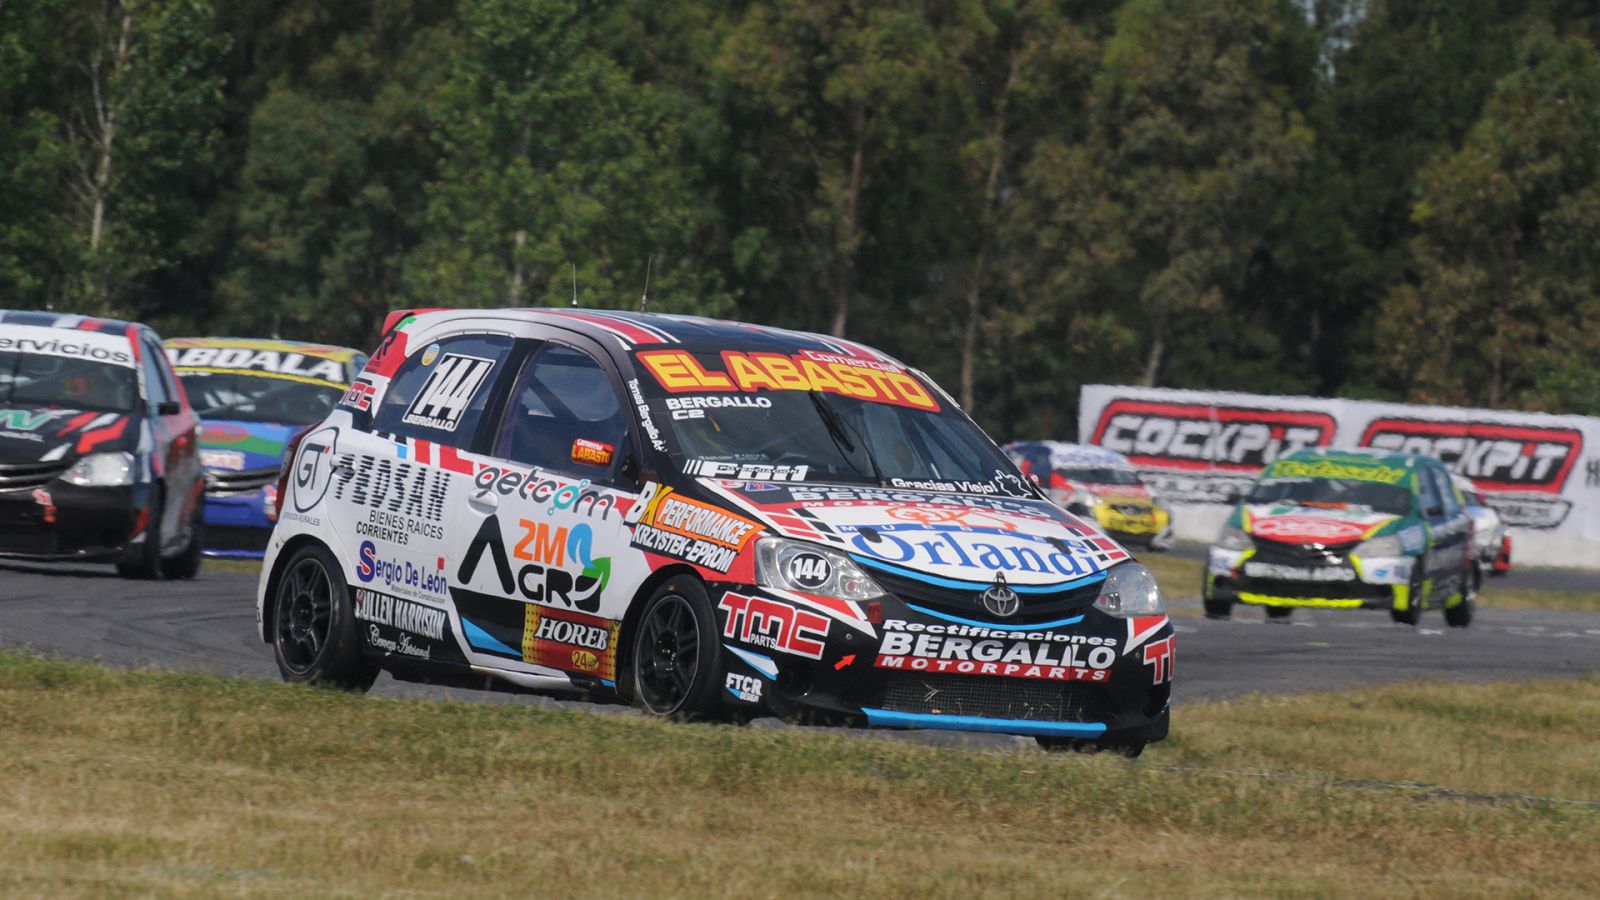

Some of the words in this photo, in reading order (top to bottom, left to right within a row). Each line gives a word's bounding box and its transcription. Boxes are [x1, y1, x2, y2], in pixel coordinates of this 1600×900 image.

[804, 350, 902, 374] Comercial
[412, 357, 491, 421] 144
[646, 351, 730, 389] EL
[727, 353, 937, 409] ABASTO
[665, 396, 772, 411] BERGALLO
[672, 409, 706, 420] C2
[406, 413, 456, 431] BERGALLO
[891, 478, 956, 492] Gracias
[369, 509, 405, 530] BIENES
[656, 498, 754, 546] PERFORMANCE
[356, 521, 409, 545] CORRIENTES
[356, 540, 403, 586] Sergio
[405, 560, 419, 587] De
[851, 531, 1105, 577] Orlandi
[792, 557, 828, 581] 144
[535, 616, 609, 650] HOREB
[718, 591, 831, 660] TMC
[882, 619, 1118, 647] Rectificaciones
[750, 633, 777, 649] PARTS
[878, 631, 1117, 669] BERGALLO
[881, 656, 1106, 680] MOTORPARTS
[1143, 632, 1176, 686] T
[725, 672, 763, 696] FTCR
